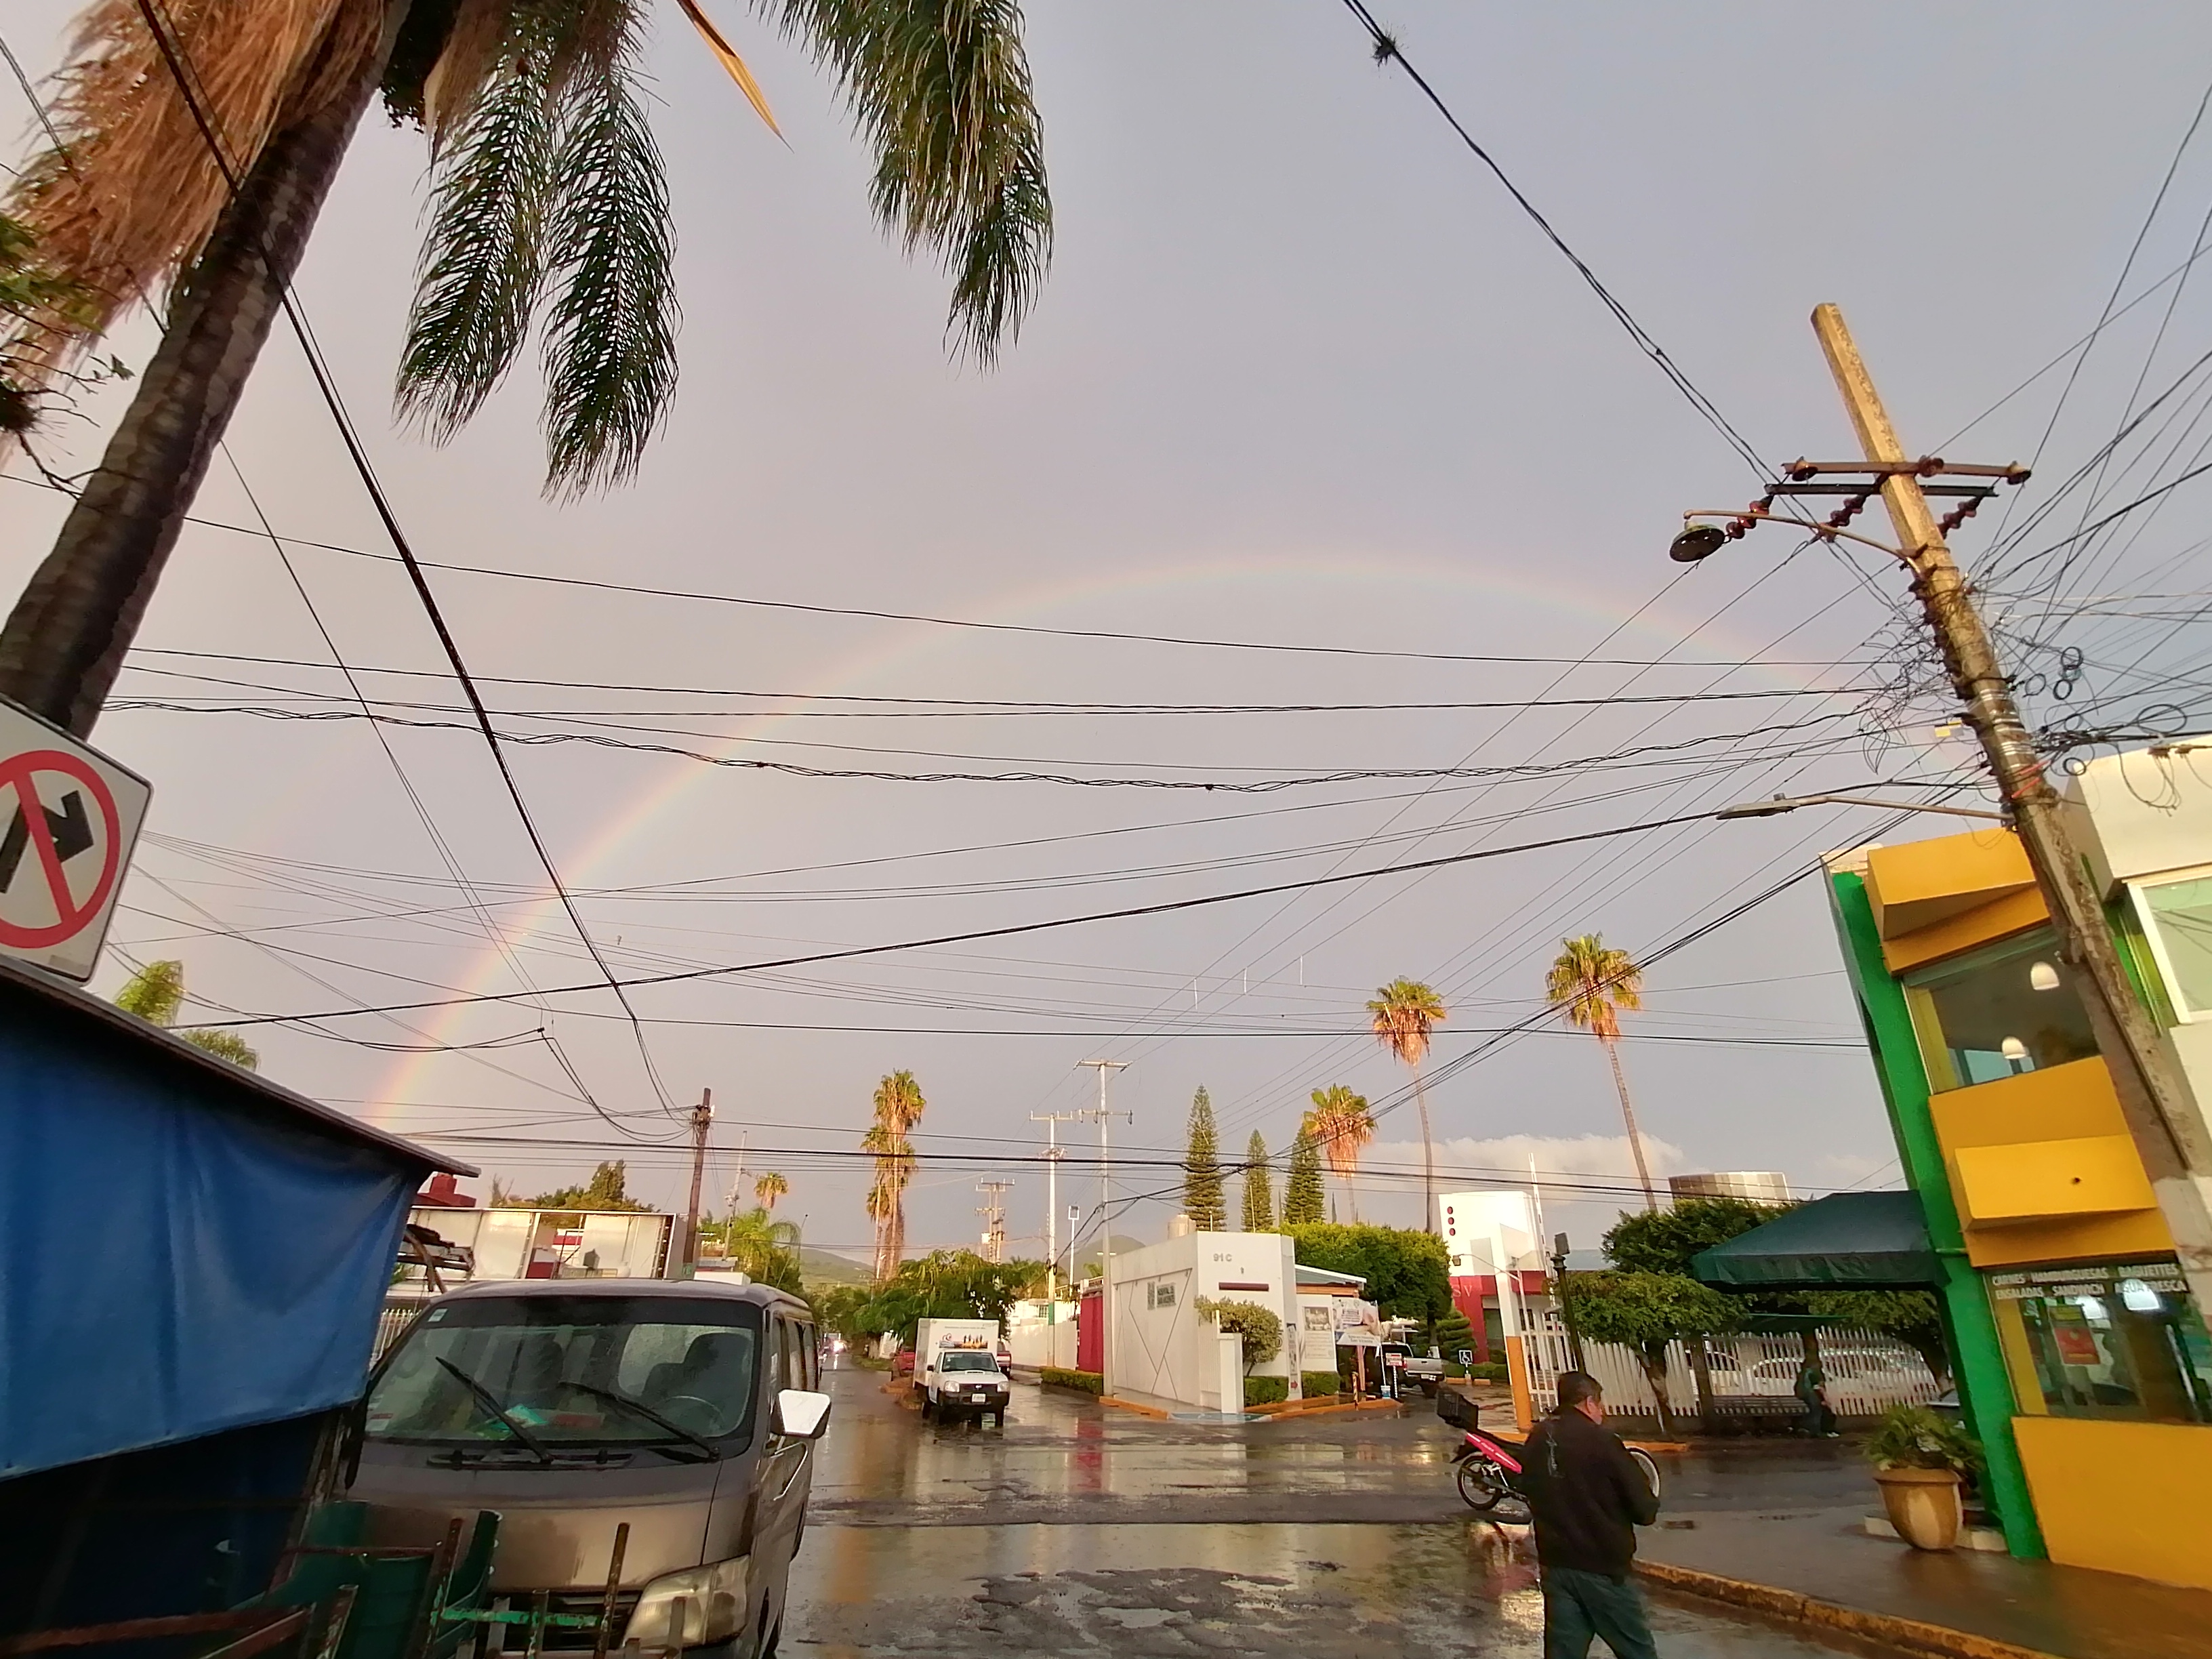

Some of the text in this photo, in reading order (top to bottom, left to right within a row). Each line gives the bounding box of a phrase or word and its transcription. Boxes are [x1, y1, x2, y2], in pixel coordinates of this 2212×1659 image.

[1992, 1263, 2180, 1286] CARNES HAMBURGUESAS BAGUETTES
[1995, 1286, 2045, 1300] ENSALADAS
[2051, 1283, 2106, 1296] SANDWICH
